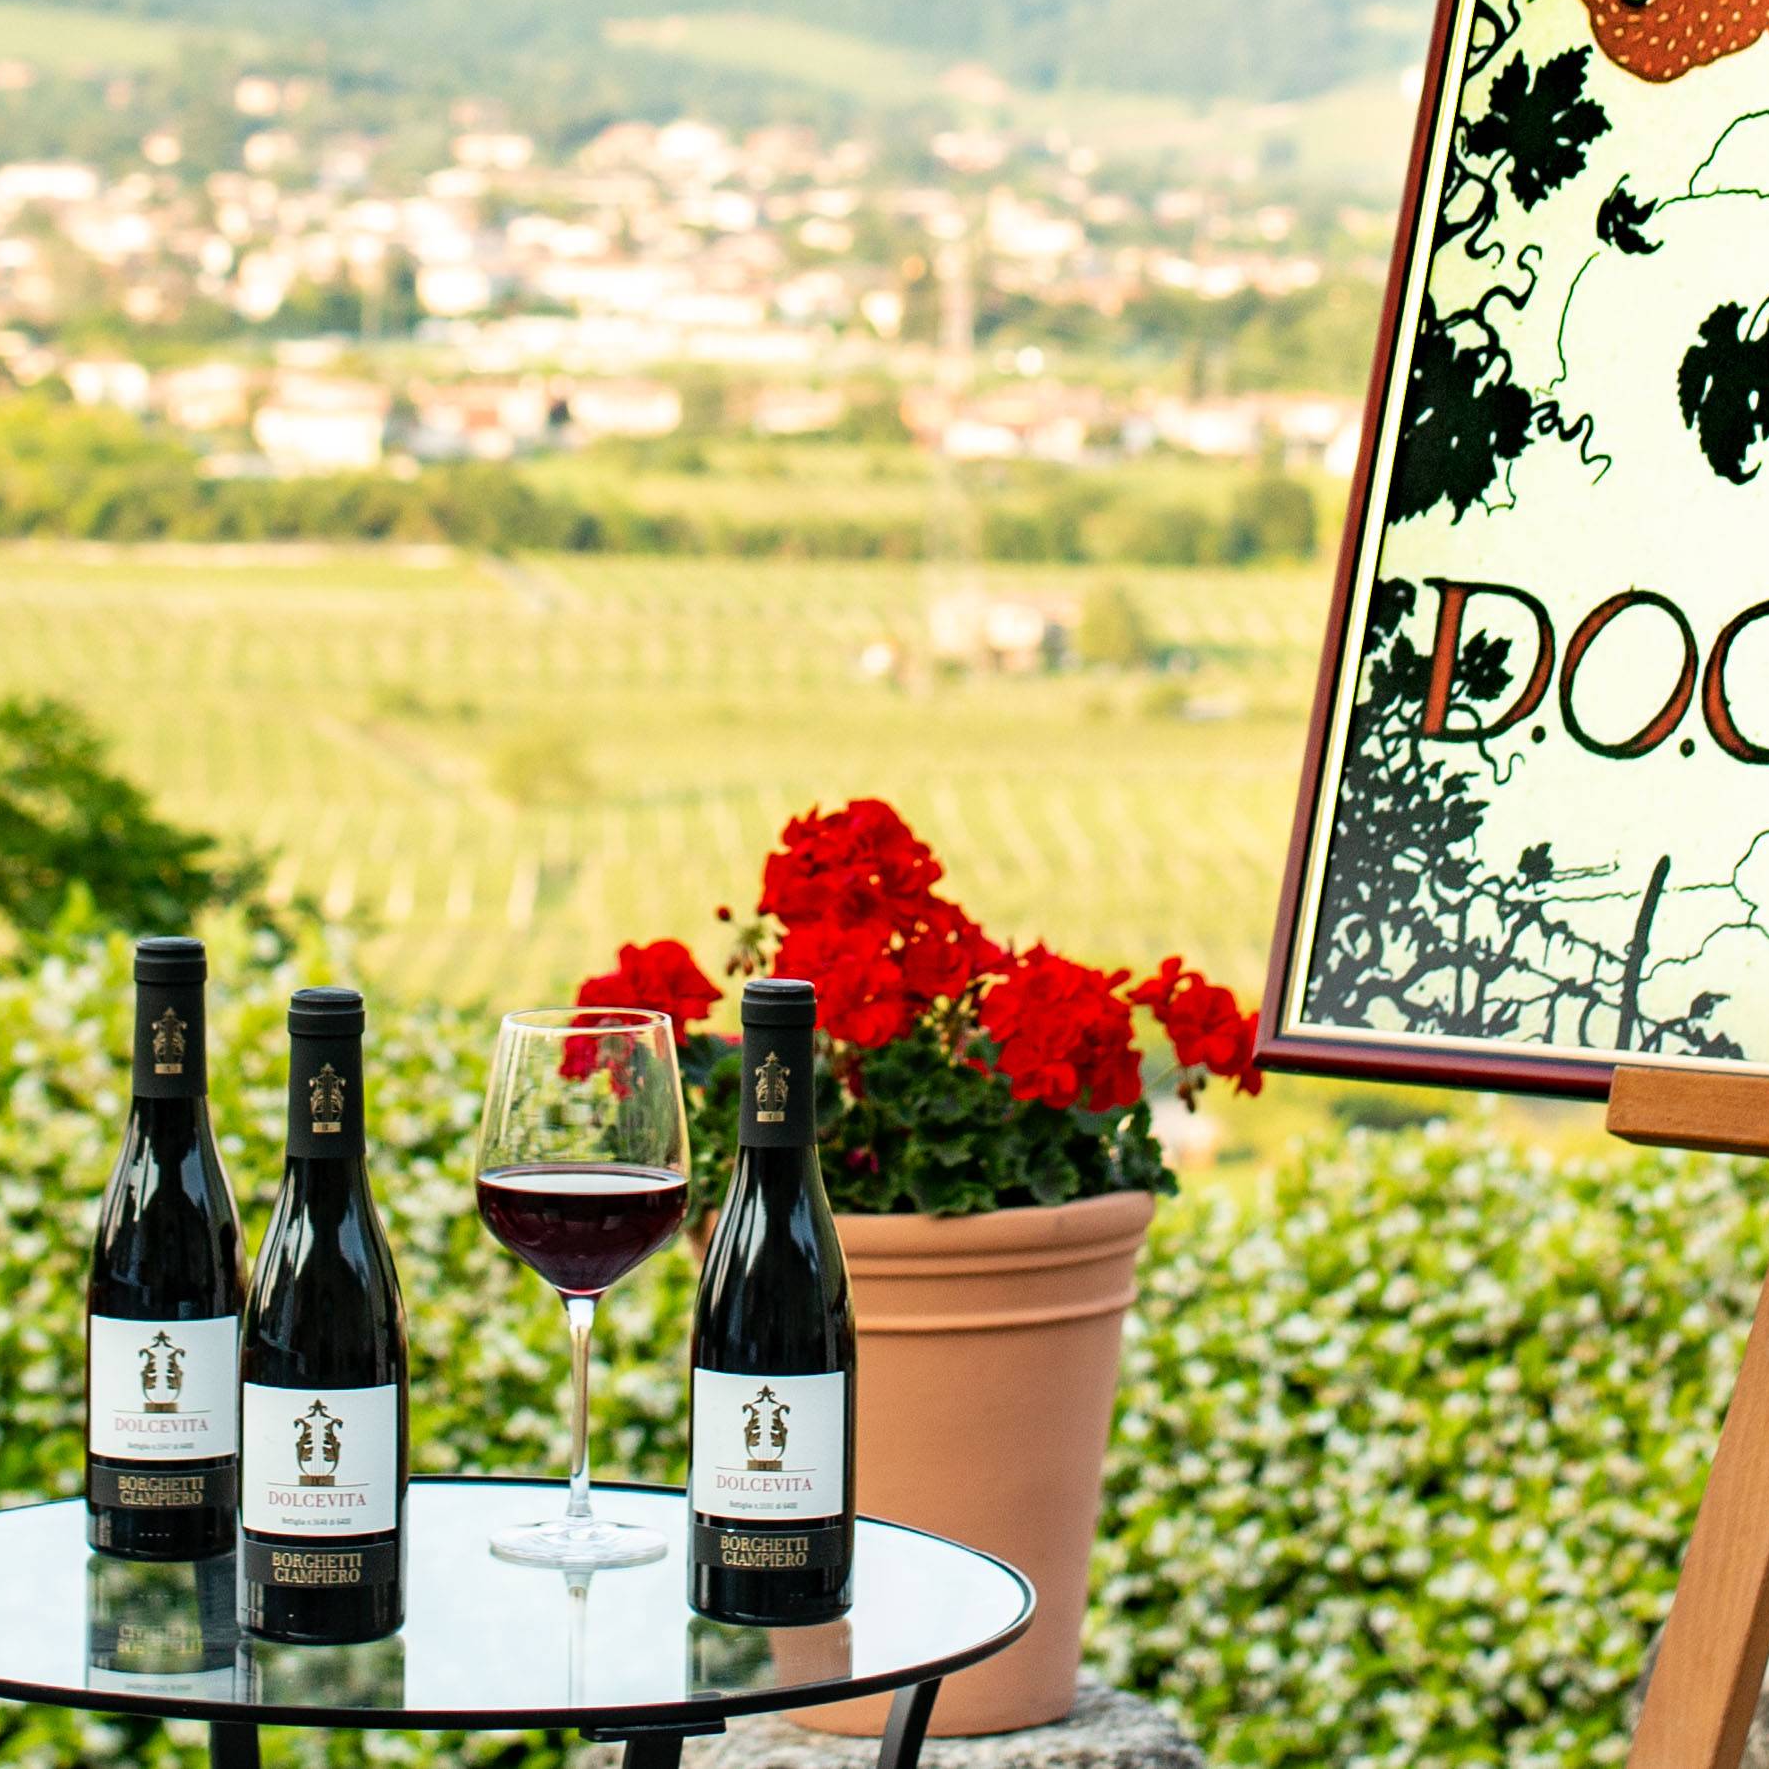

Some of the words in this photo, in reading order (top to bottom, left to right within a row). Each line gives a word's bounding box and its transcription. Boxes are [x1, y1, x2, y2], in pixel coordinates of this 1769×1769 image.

[114, 1417, 209, 1433] DOLCEVITA
[117, 1475, 205, 1491] BORGHETTI
[716, 1474, 813, 1492] DOLCEVITA
[119, 1490, 204, 1505] GIAMPIERO
[268, 1490, 366, 1508] DOLCEVITA
[720, 1535, 809, 1551] BORGHETTI
[271, 1551, 363, 1568] BORGHETTI
[722, 1550, 808, 1567] GIAMPIERO
[273, 1567, 361, 1584] GIAMPIERO
